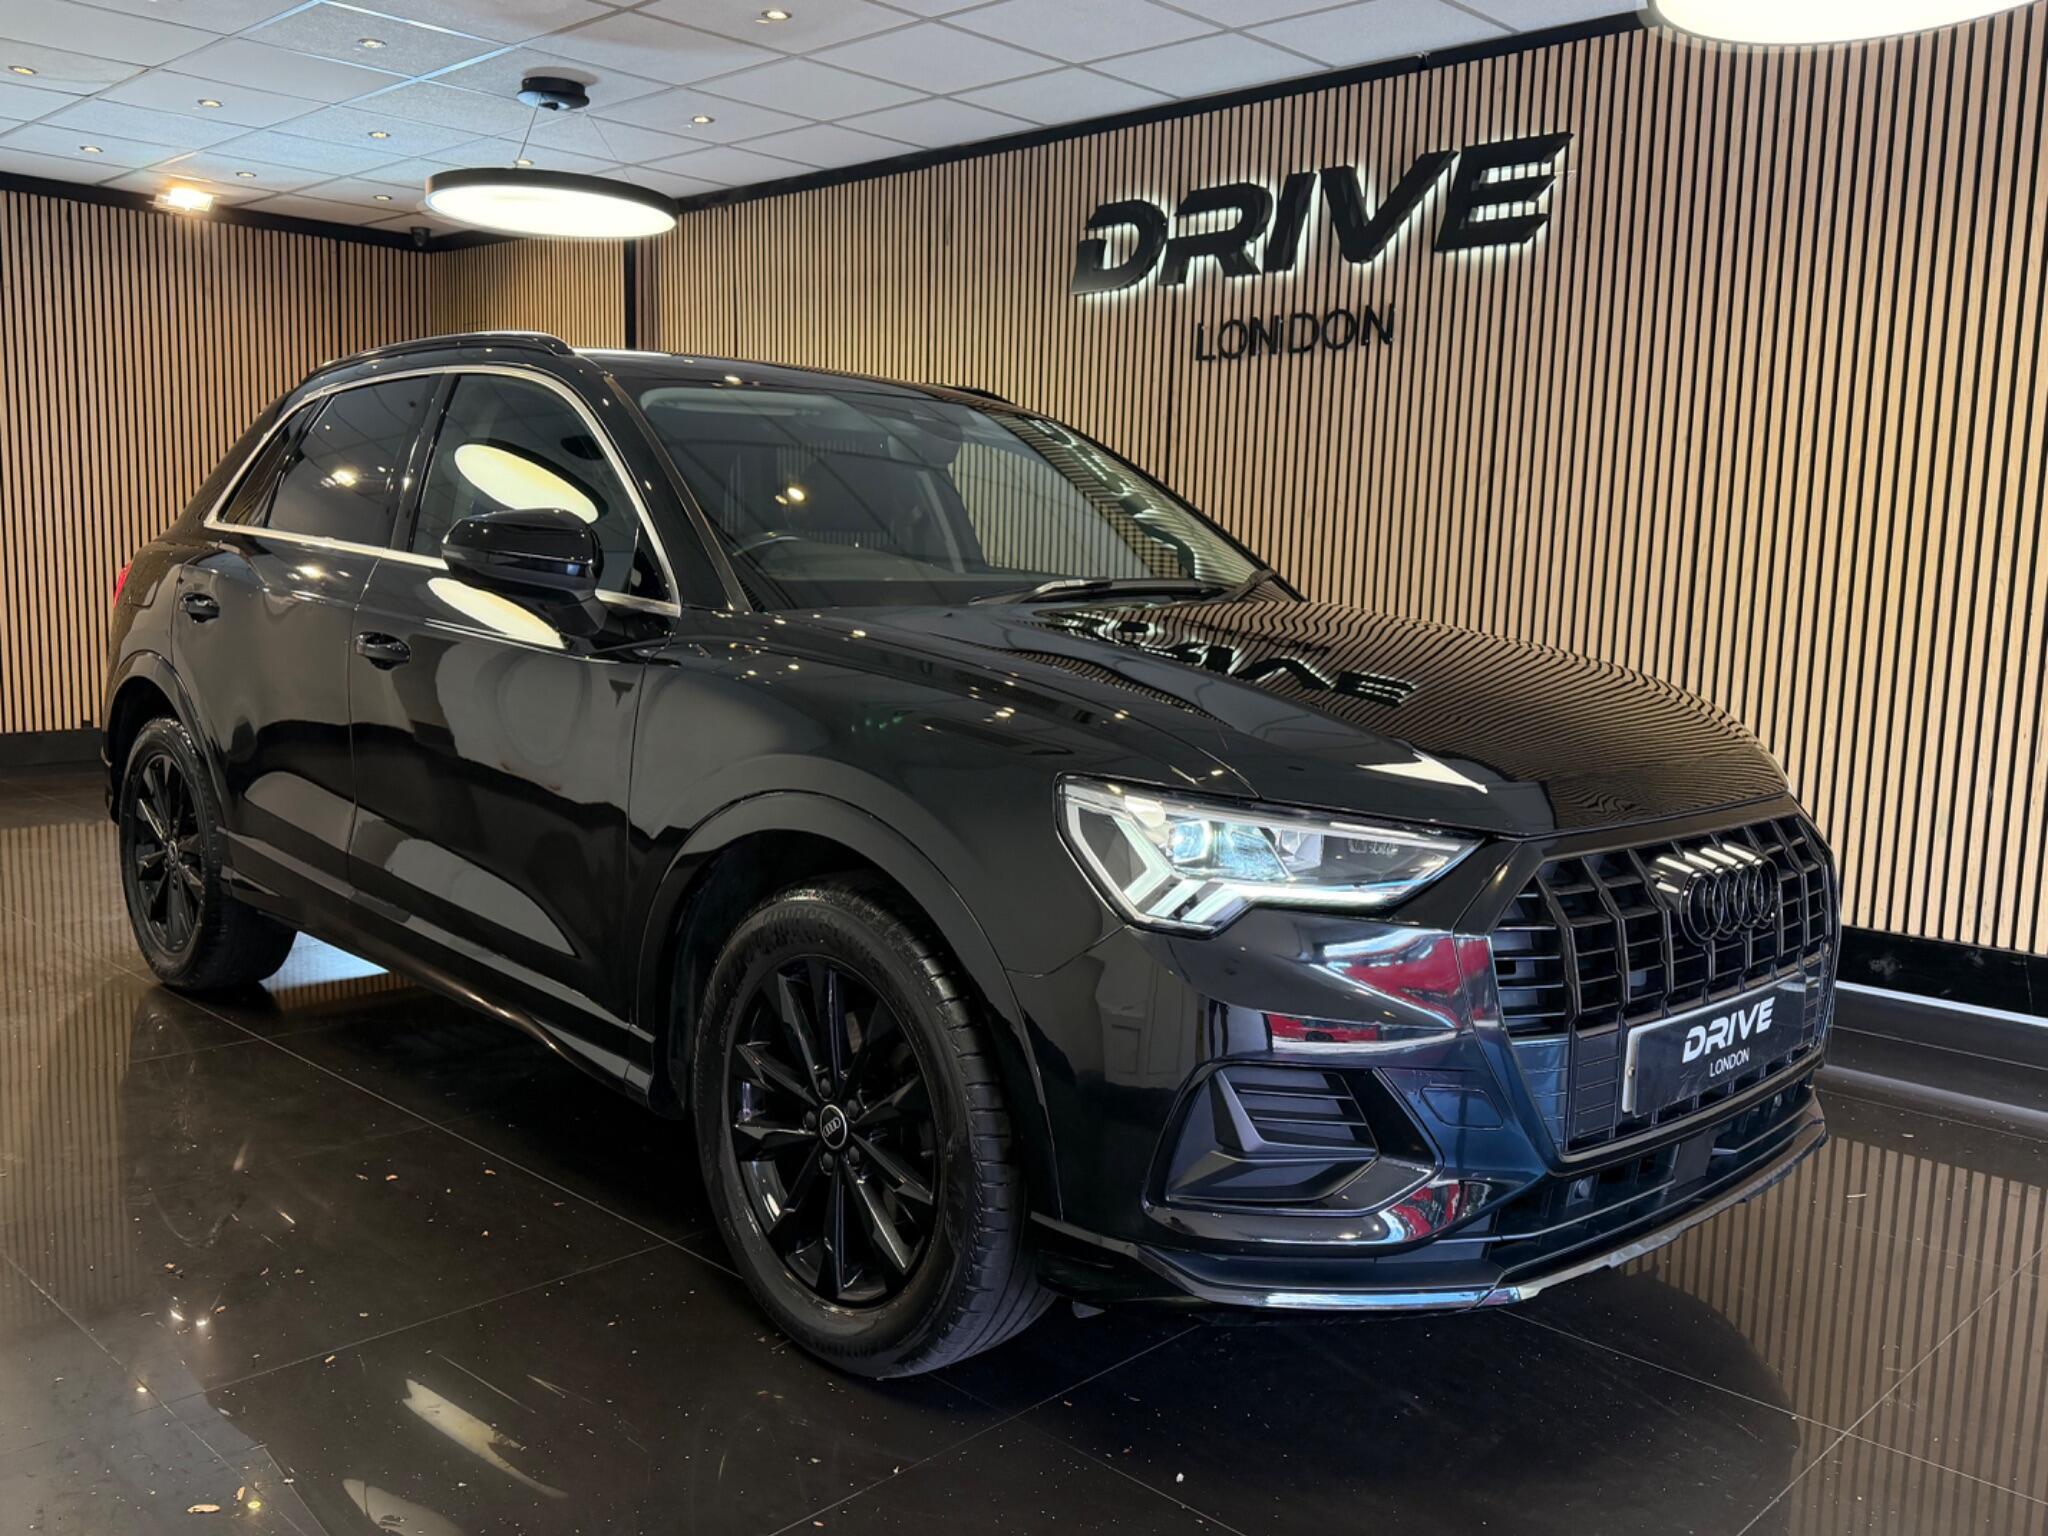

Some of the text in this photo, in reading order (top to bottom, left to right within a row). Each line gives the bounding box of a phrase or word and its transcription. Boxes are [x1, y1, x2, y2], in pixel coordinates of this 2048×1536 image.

[1071, 131, 1575, 295] DRIVE
[1195, 303, 1396, 362] LONDON
[1682, 997, 1776, 1064] DRIVE
[1710, 1047, 1750, 1078] LONDON
